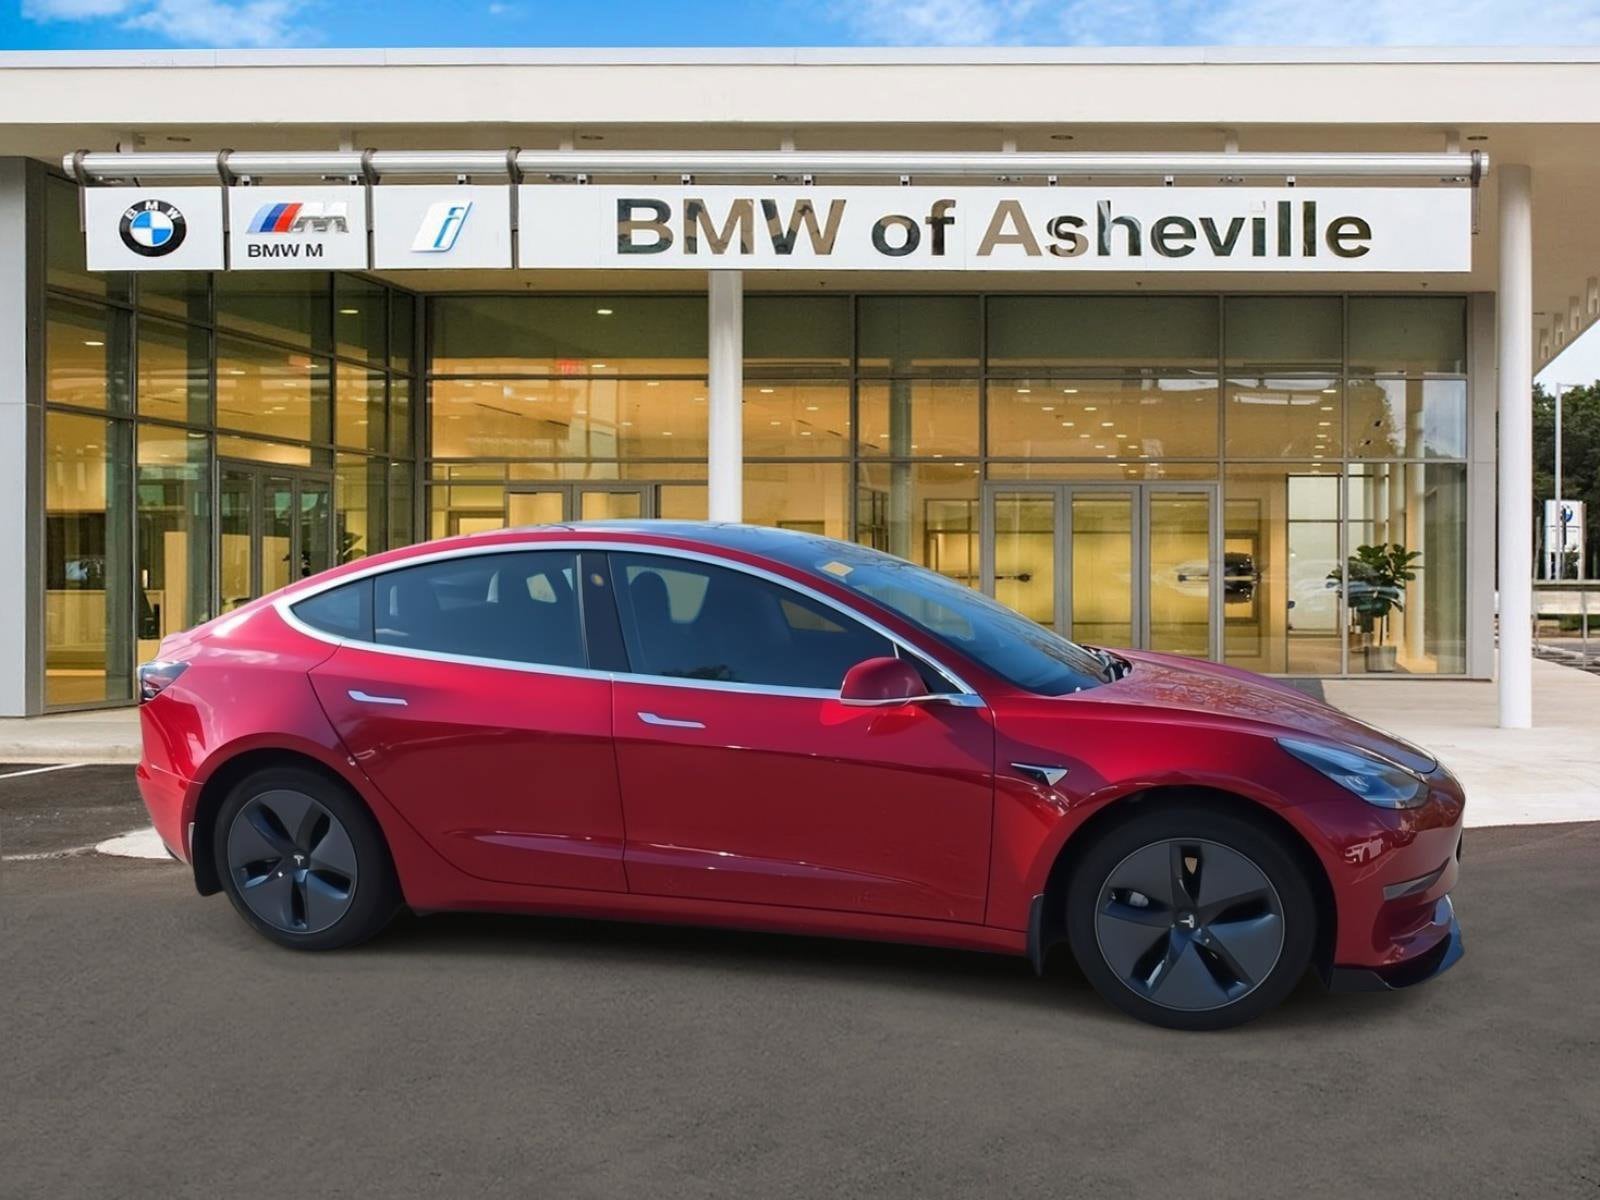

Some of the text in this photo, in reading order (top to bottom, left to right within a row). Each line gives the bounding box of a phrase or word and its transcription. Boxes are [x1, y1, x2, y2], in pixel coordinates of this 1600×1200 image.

[125, 200, 181, 220] BMW
[616, 198, 1372, 258] BMW of Asheville
[247, 243, 323, 257] BMW M
